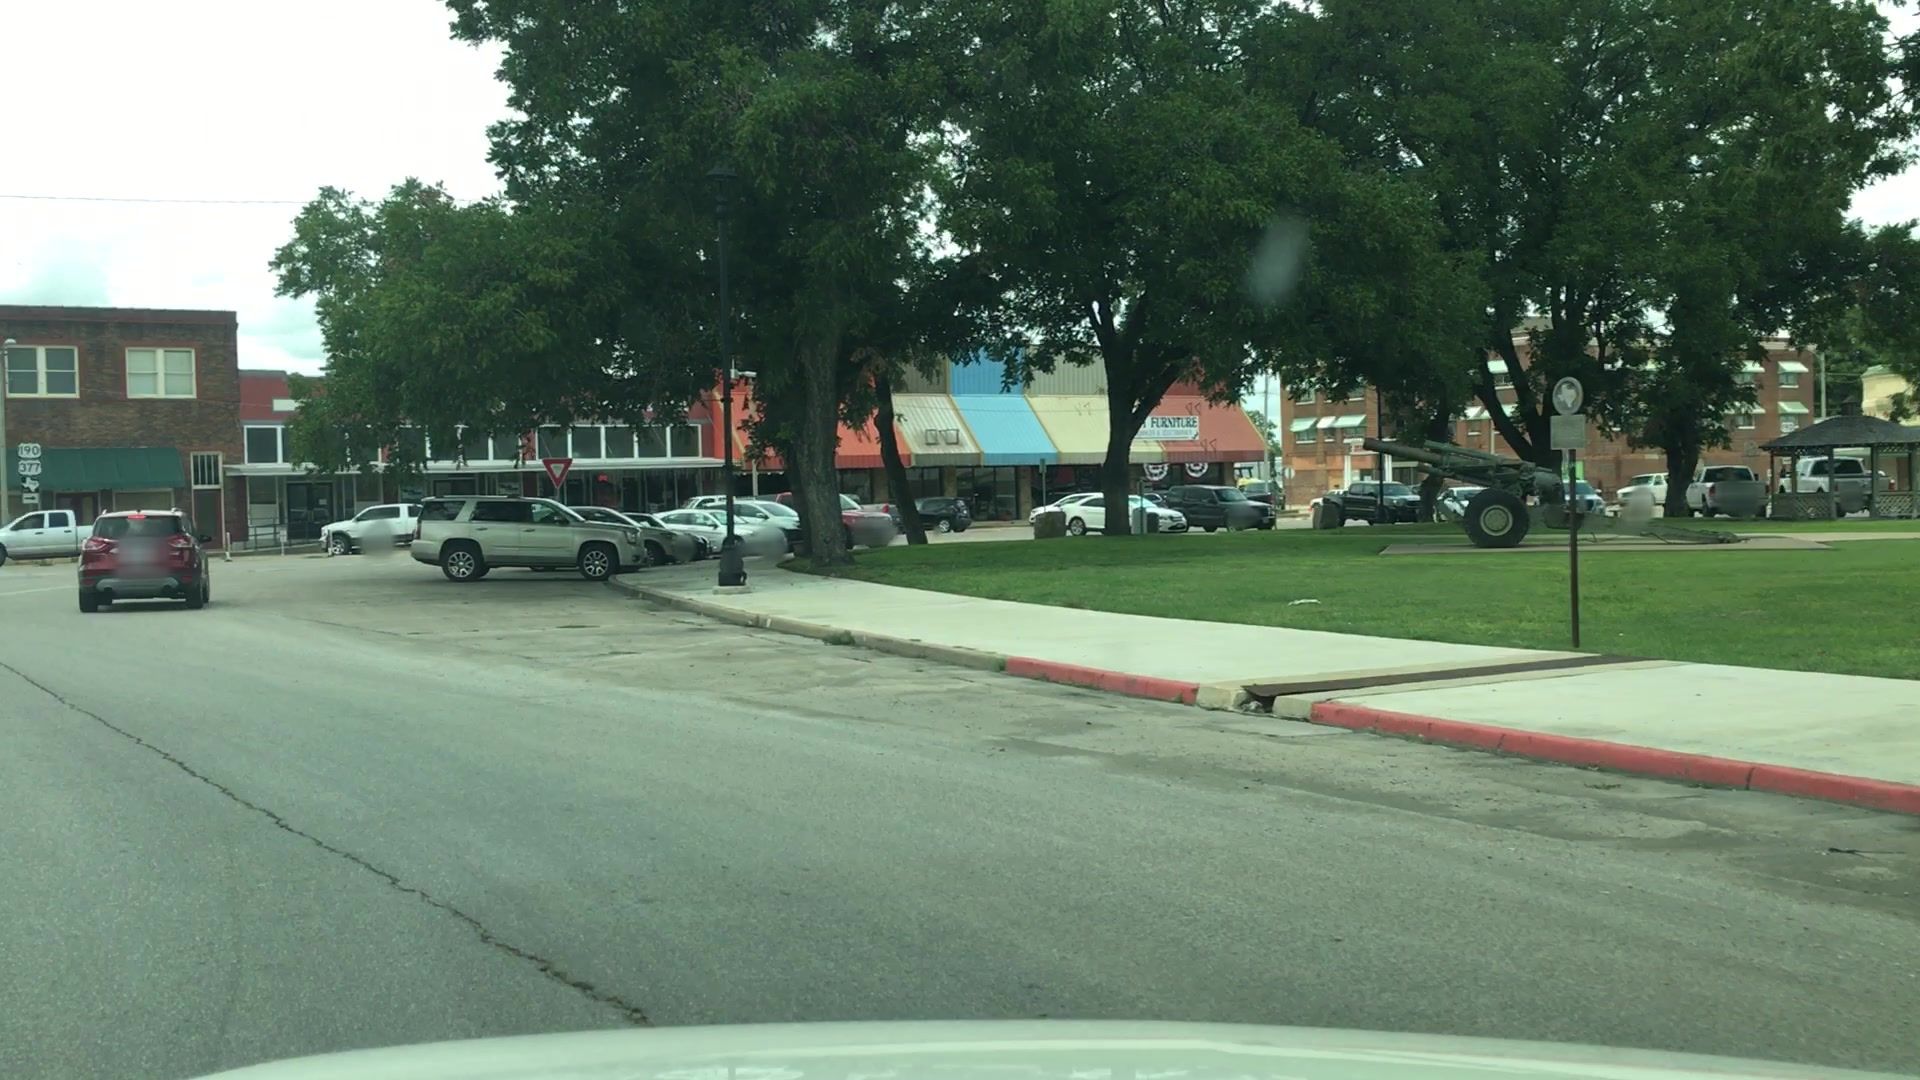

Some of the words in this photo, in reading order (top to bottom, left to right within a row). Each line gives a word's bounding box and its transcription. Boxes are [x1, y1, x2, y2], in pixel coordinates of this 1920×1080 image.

[1151, 417, 1197, 428] FURNITURE
[20, 446, 39, 456] 190
[20, 462, 40, 473] 377
